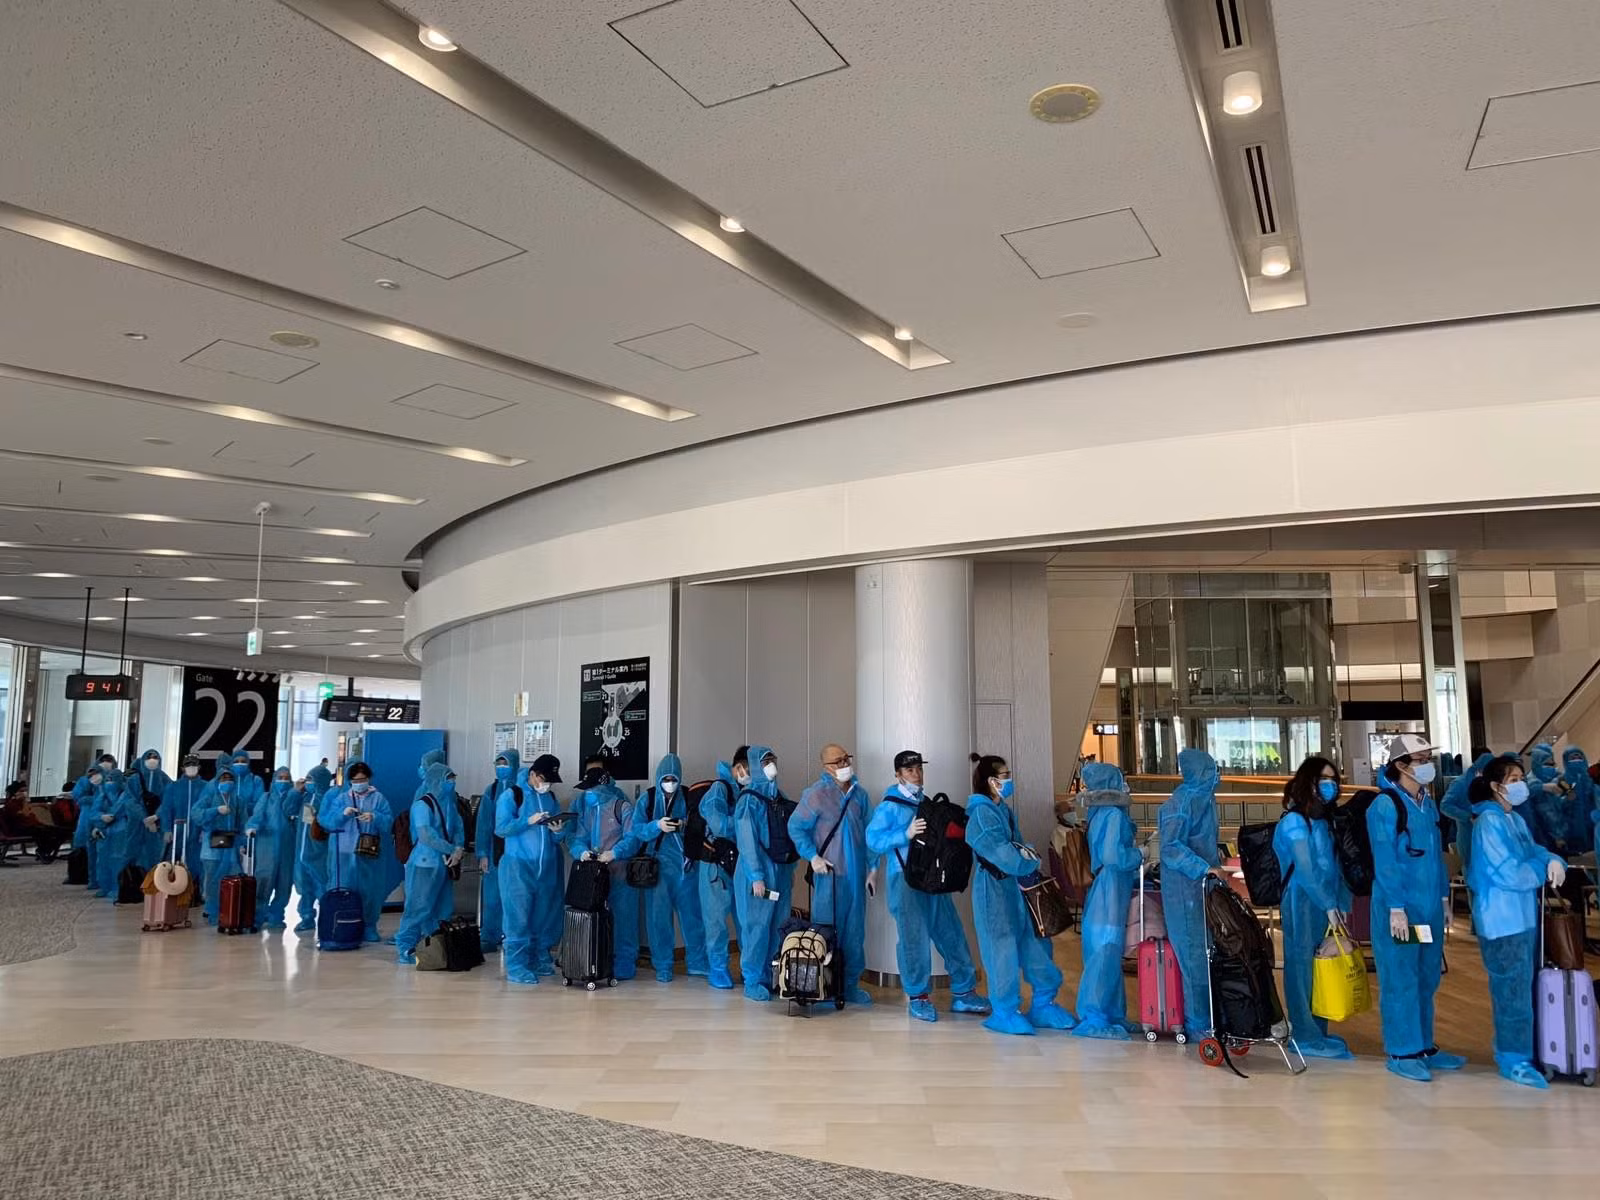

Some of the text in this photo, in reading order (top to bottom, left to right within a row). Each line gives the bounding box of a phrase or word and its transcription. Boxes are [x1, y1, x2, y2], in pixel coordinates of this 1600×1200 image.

[195, 673, 213, 683] Gate
[387, 707, 403, 720] 22
[190, 687, 265, 760] 22
